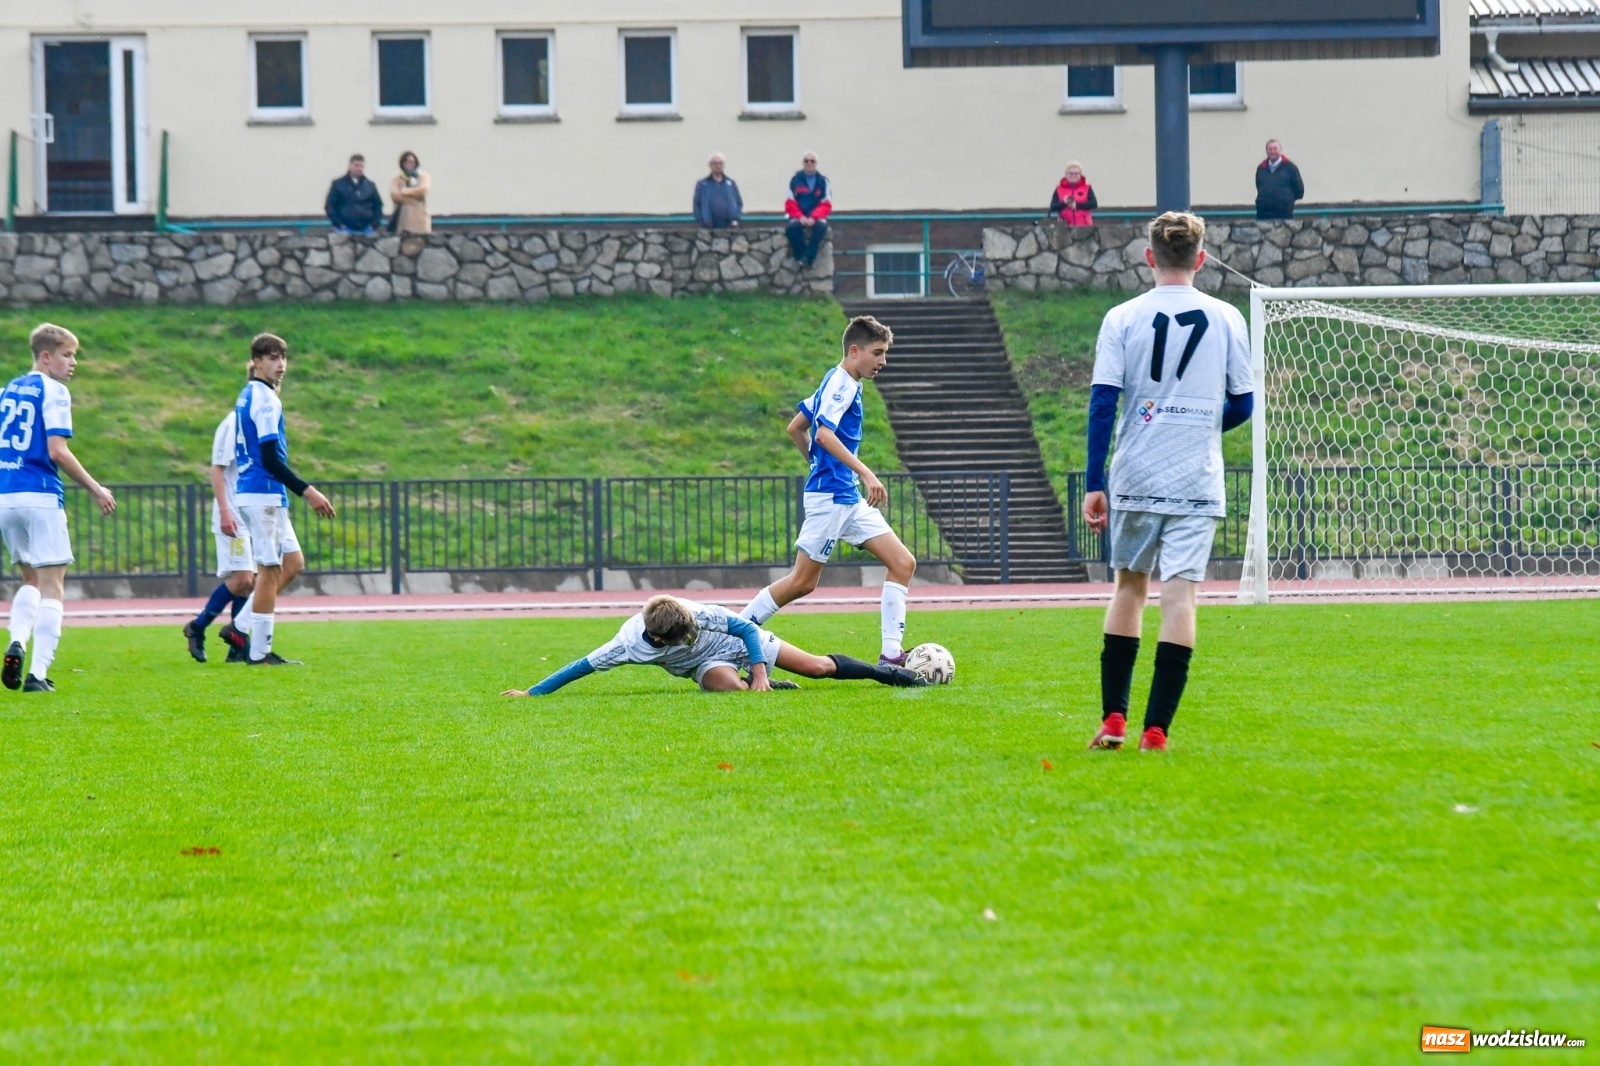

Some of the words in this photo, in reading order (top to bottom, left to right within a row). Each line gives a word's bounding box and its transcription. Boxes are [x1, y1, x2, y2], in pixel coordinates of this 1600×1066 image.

[1150, 309, 1209, 383] 17
[0, 398, 36, 452] 23
[230, 538, 244, 557] 15
[819, 538, 836, 557] 16
